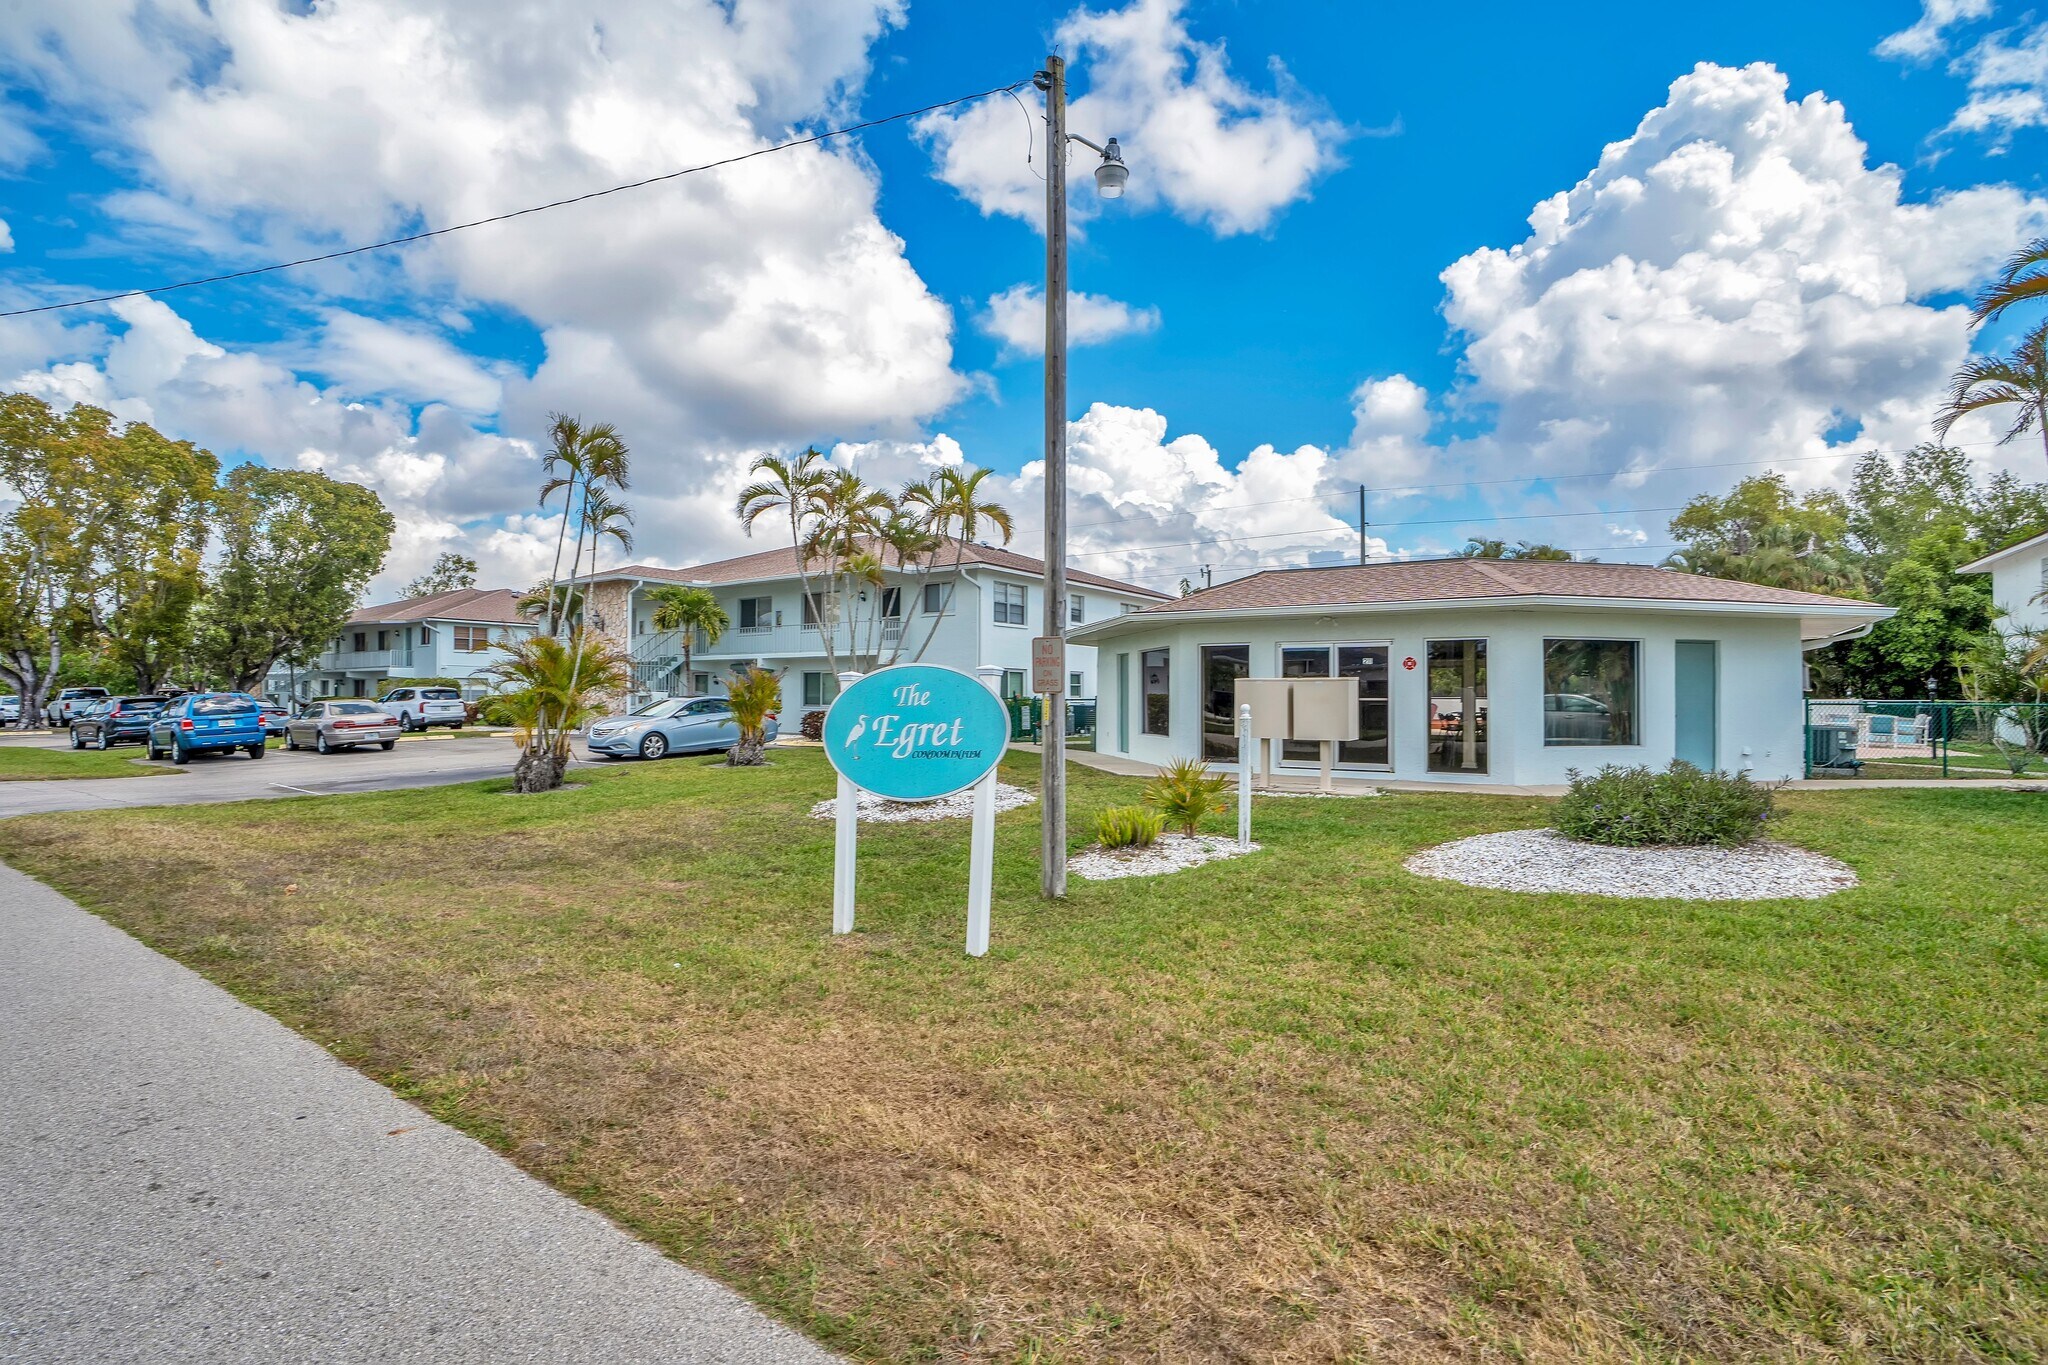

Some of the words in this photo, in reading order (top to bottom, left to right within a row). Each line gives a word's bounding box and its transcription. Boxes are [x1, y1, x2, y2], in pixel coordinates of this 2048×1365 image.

[1042, 644, 1053, 655] NO
[1035, 656, 1060, 667] PARKING
[1043, 669, 1053, 677] ON
[1037, 679, 1059, 687] GRASS
[893, 683, 931, 707] The
[872, 714, 965, 759] Egret
[911, 749, 982, 760] CONDOMINIUM
